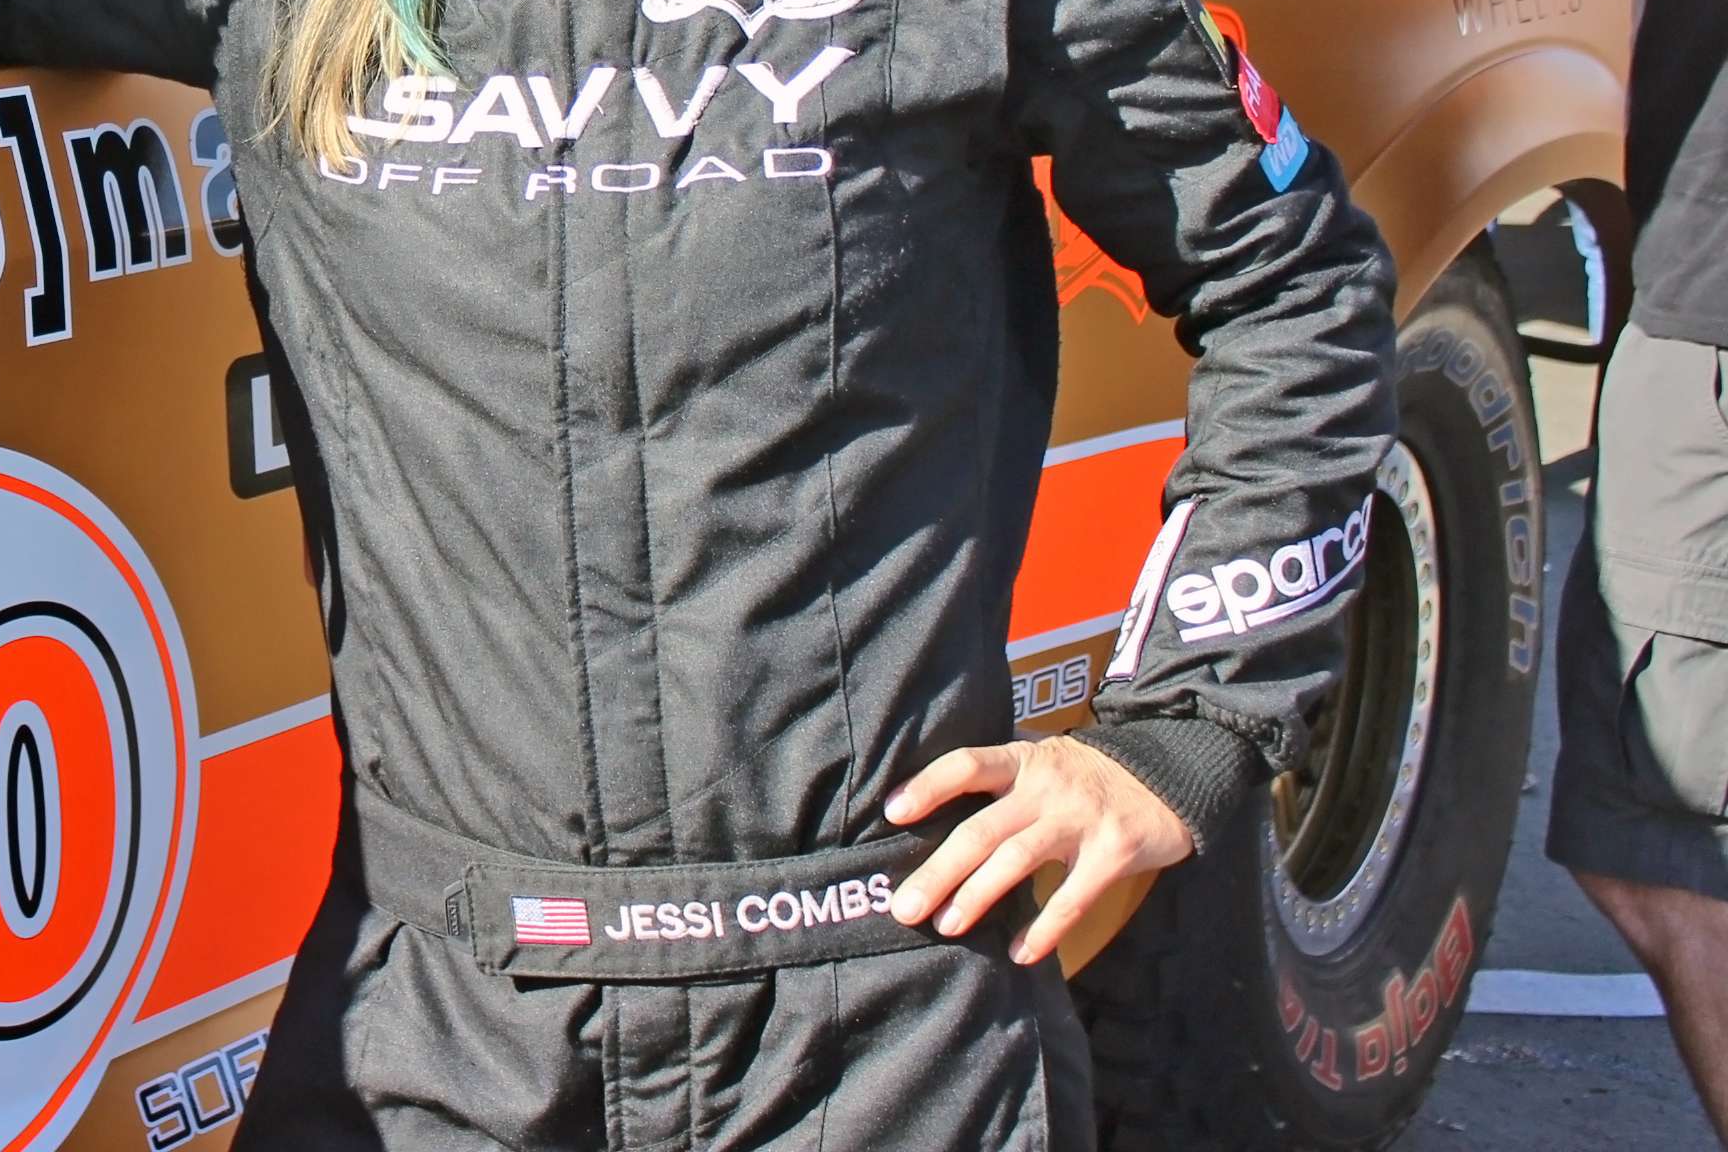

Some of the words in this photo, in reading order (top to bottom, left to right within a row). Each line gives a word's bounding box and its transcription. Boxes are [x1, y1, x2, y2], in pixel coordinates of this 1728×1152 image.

[348, 46, 857, 149] SAVVY
[320, 154, 483, 195] OFF
[525, 148, 834, 200] ROAD
[1392, 326, 1541, 675] oodrich
[1167, 493, 1373, 640] sparco
[604, 899, 725, 942] JESSI
[736, 873, 894, 933] COMBS
[1353, 896, 1473, 1082] Baja
